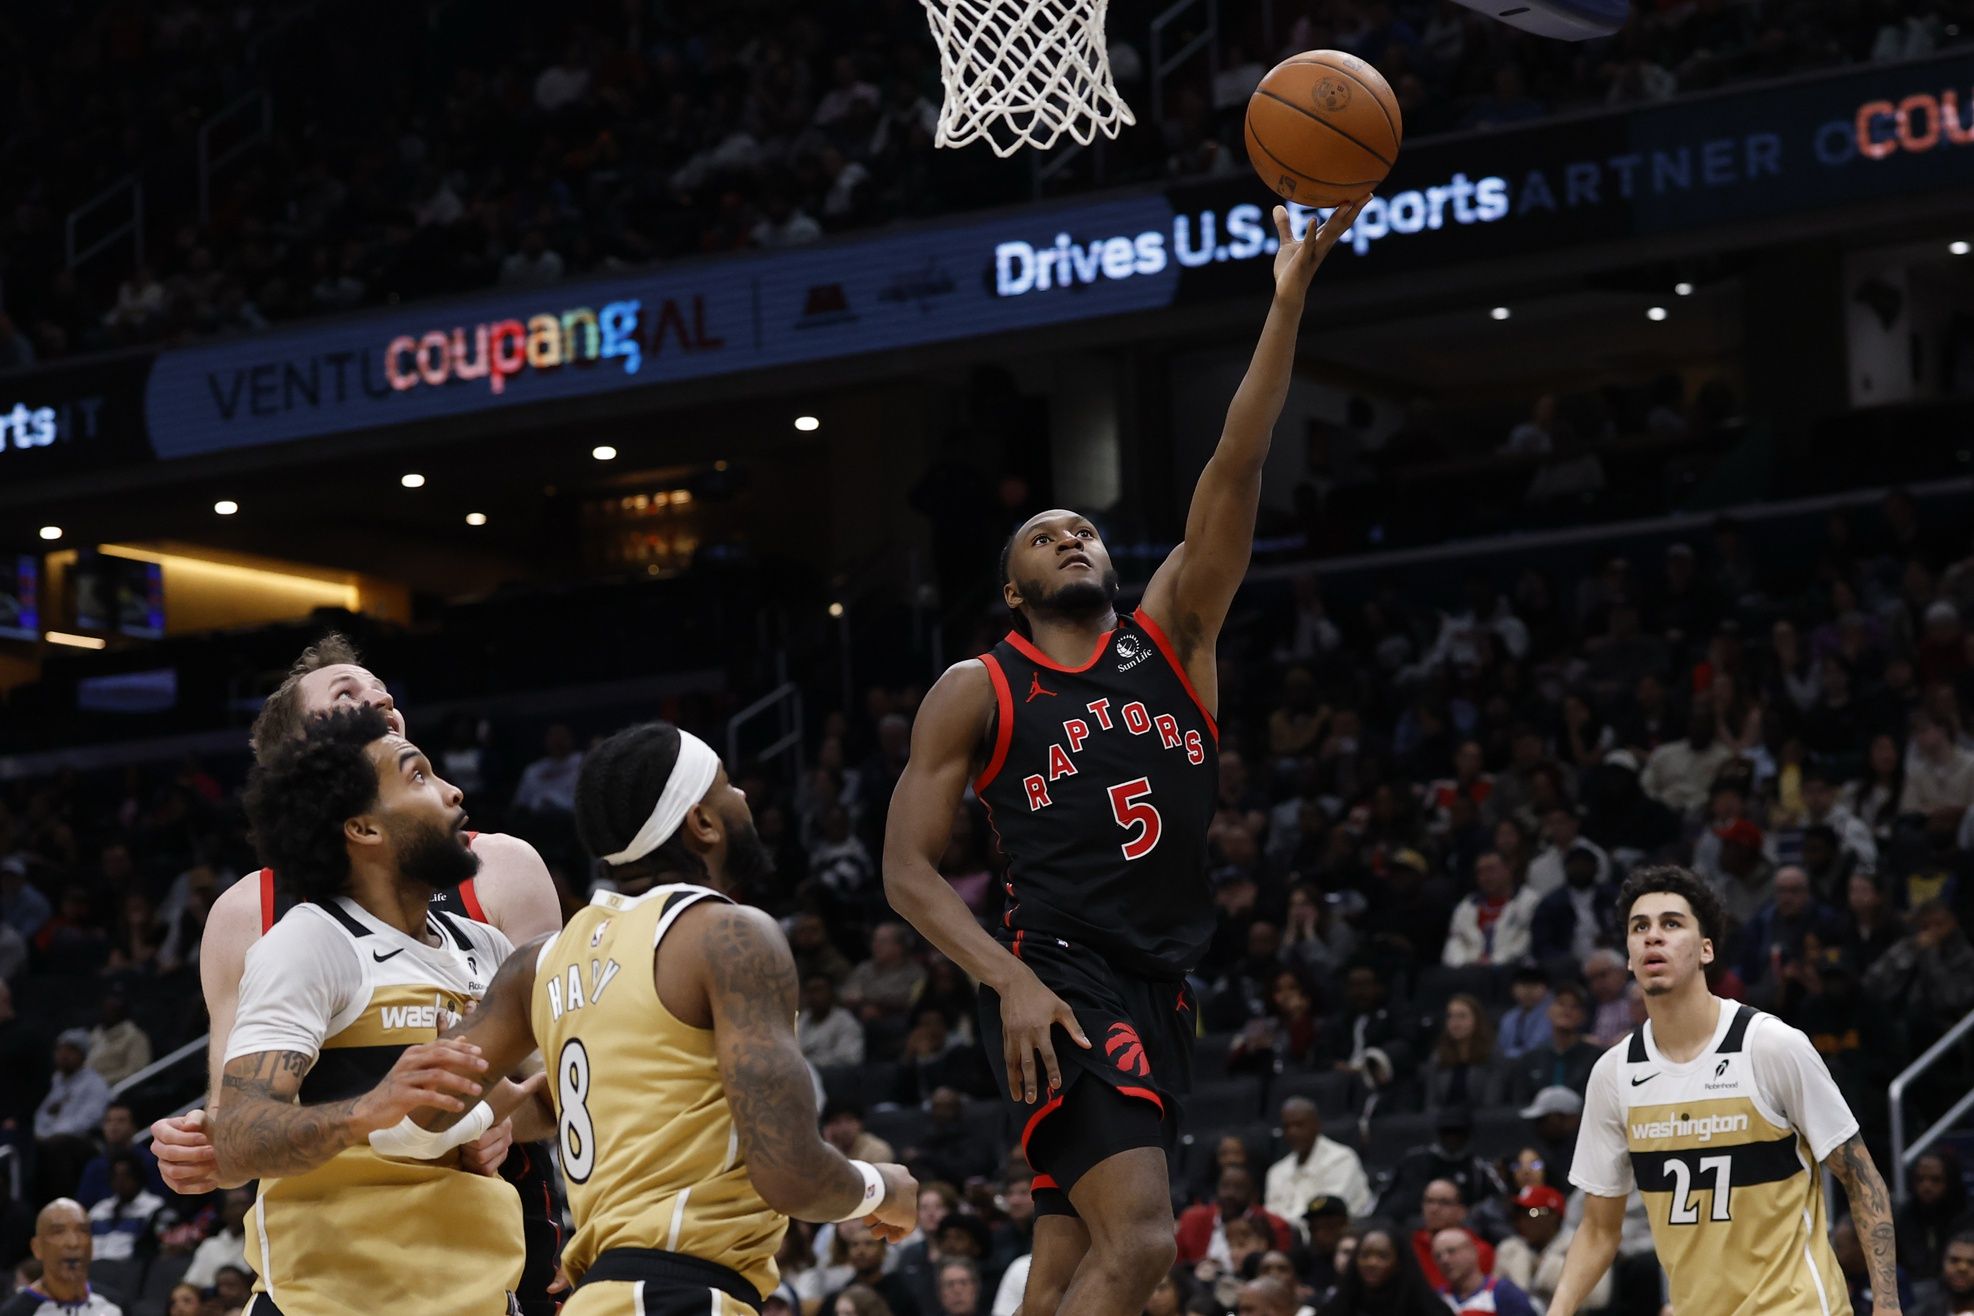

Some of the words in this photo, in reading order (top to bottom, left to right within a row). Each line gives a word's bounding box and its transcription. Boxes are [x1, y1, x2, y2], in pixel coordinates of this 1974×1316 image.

[995, 232, 1167, 297] Drives
[1173, 203, 1279, 268] U.S.
[385, 299, 642, 394] coupang
[1117, 659, 1137, 673] Sun
[1136, 648, 1153, 667] Life
[1023, 697, 1205, 812] RAPTORS
[1106, 776, 1163, 861] 5
[557, 1036, 596, 1185] 8
[1631, 1111, 1749, 1142] washington
[1662, 1154, 1733, 1226] 27
